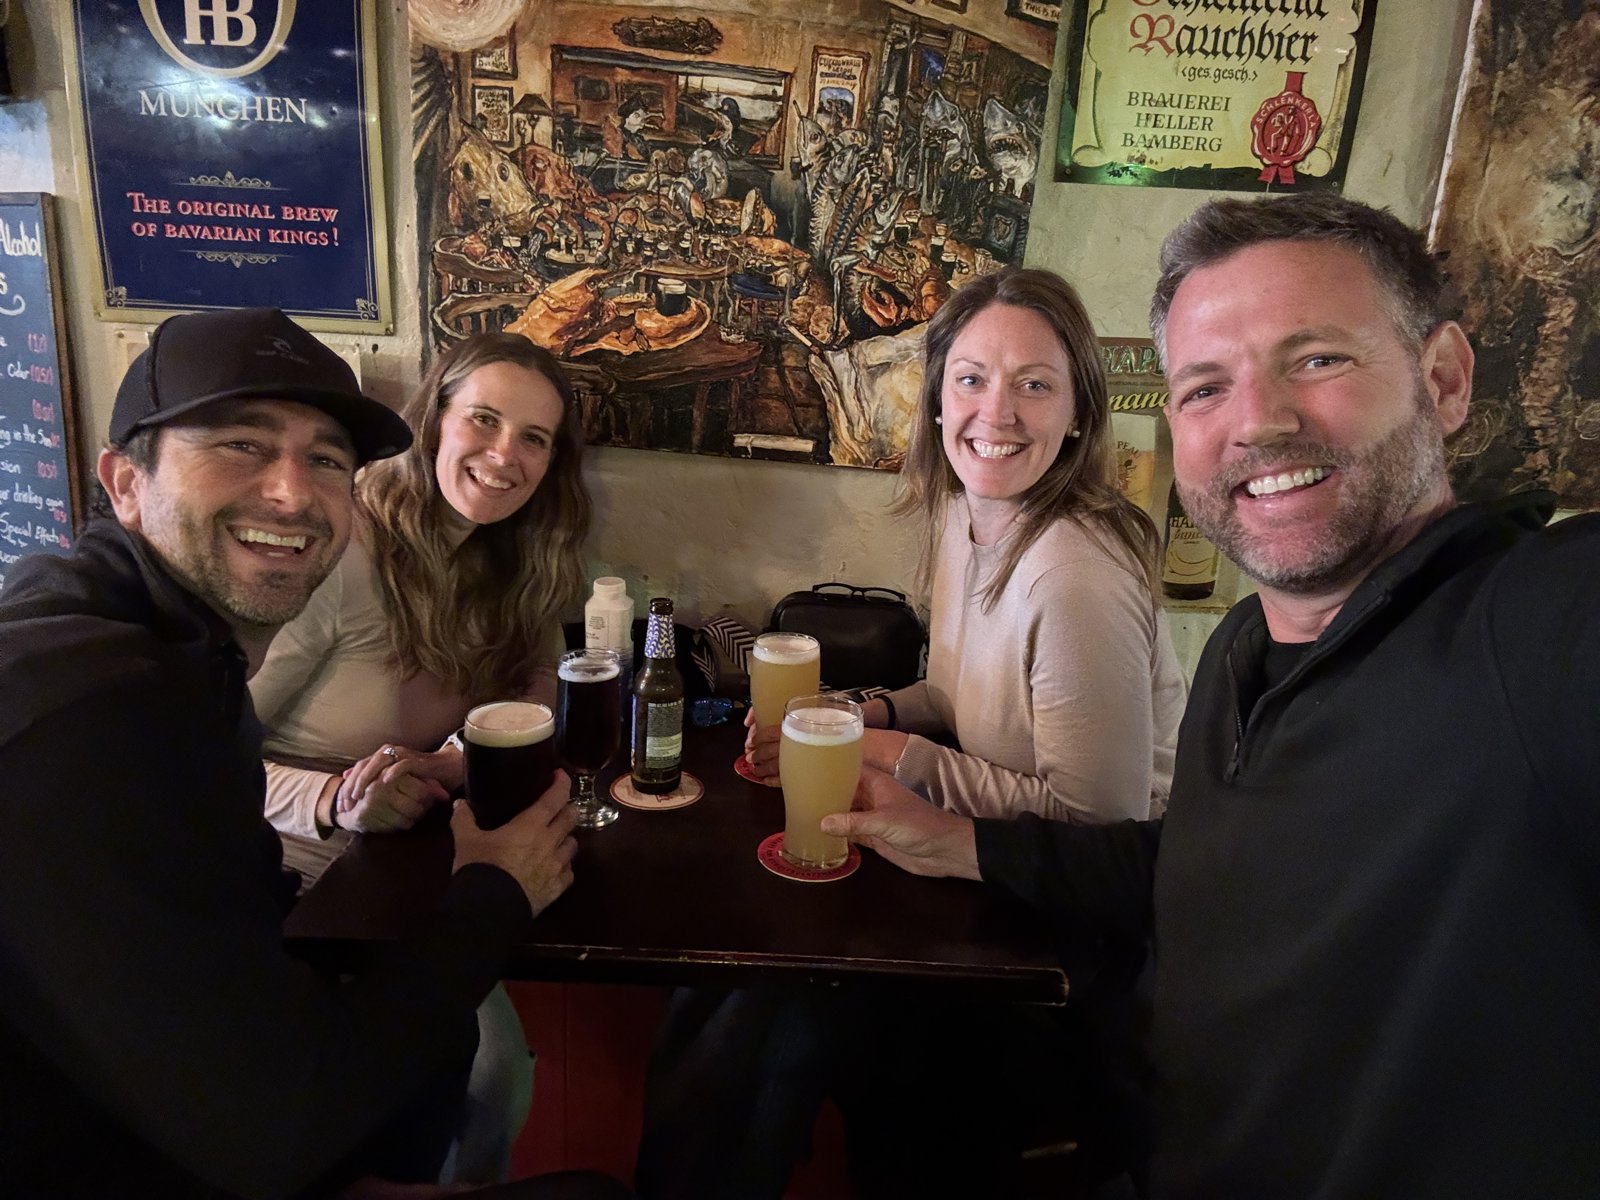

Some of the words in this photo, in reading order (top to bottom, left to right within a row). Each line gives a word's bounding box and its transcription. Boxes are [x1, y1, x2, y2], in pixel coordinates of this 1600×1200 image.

[1129, 13, 1319, 66] Rauchbier
[1126, 91, 1233, 112] BRAUEREI
[1255, 96, 1317, 128] SCHLENKERLA
[1134, 112, 1215, 132] HELLER
[1121, 132, 1223, 153] BAMBERG
[177, 200, 276, 220] ORIGINAL
[281, 205, 339, 223] BREW
[131, 222, 158, 237] OF
[164, 223, 261, 243] BAVARIAN
